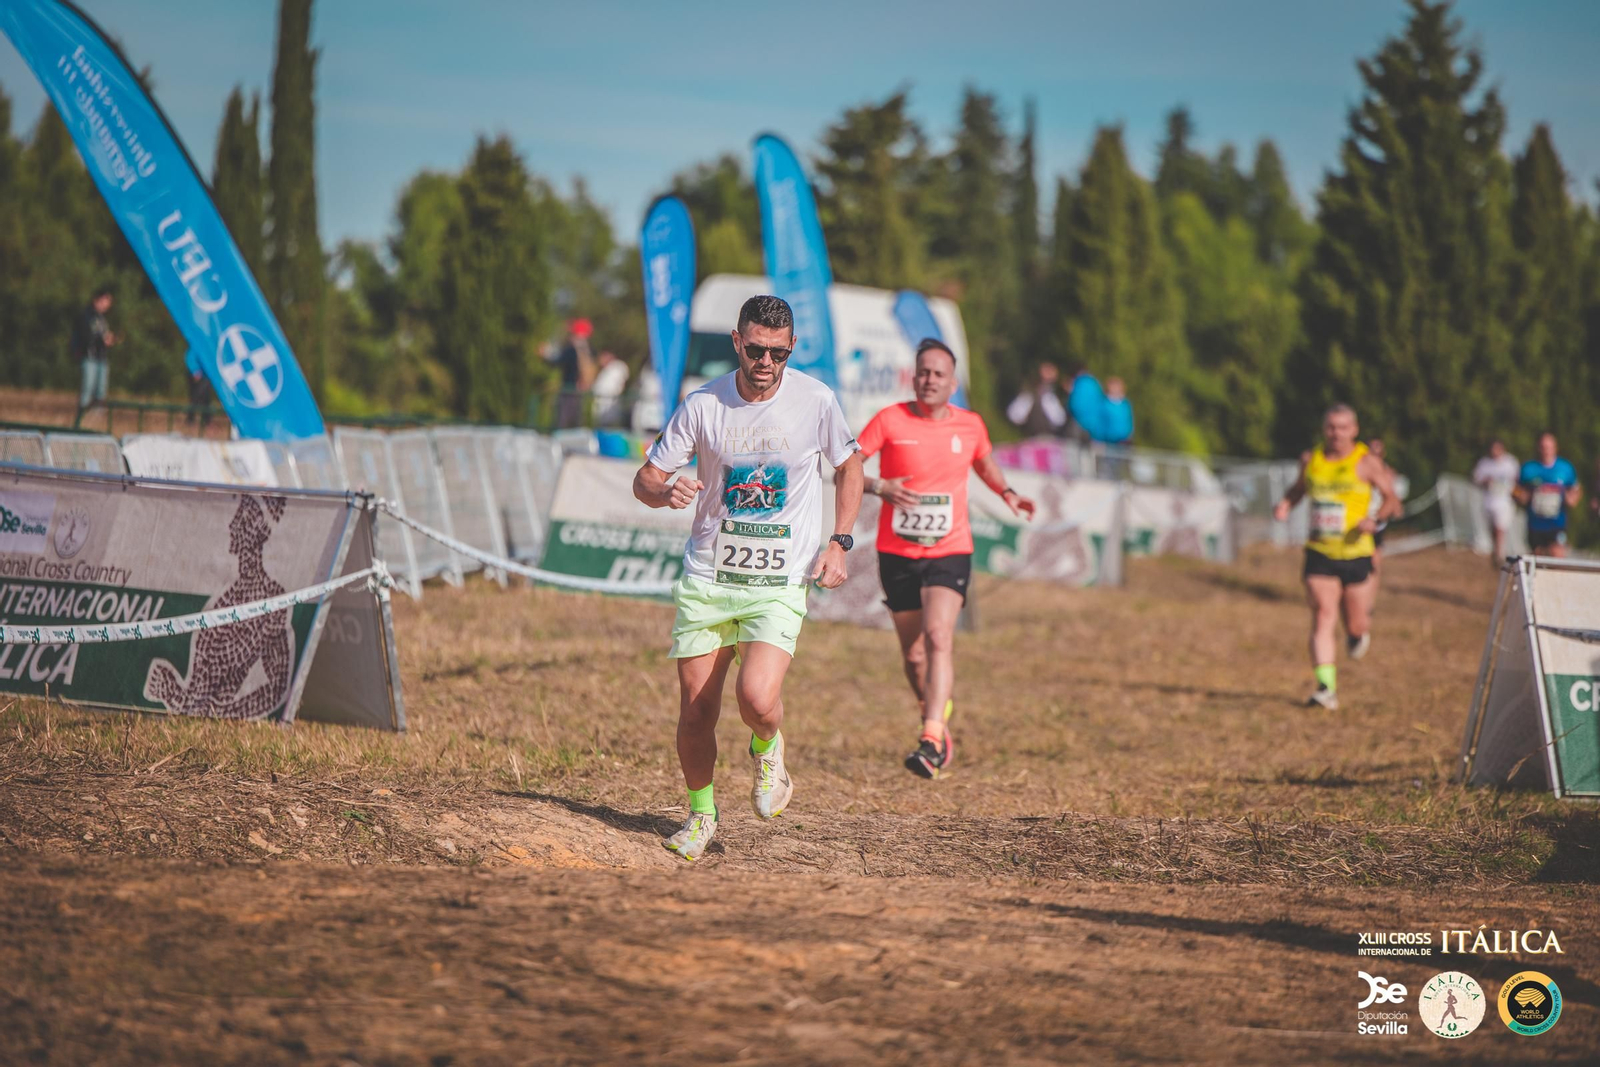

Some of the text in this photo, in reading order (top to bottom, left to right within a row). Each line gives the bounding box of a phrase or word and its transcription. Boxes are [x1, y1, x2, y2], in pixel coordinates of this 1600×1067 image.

[900, 510, 947, 531] 2222
[722, 545, 785, 570] 2235
[34, 557, 72, 580] Cross
[74, 561, 132, 588] Country
[0, 643, 80, 686] LICA
